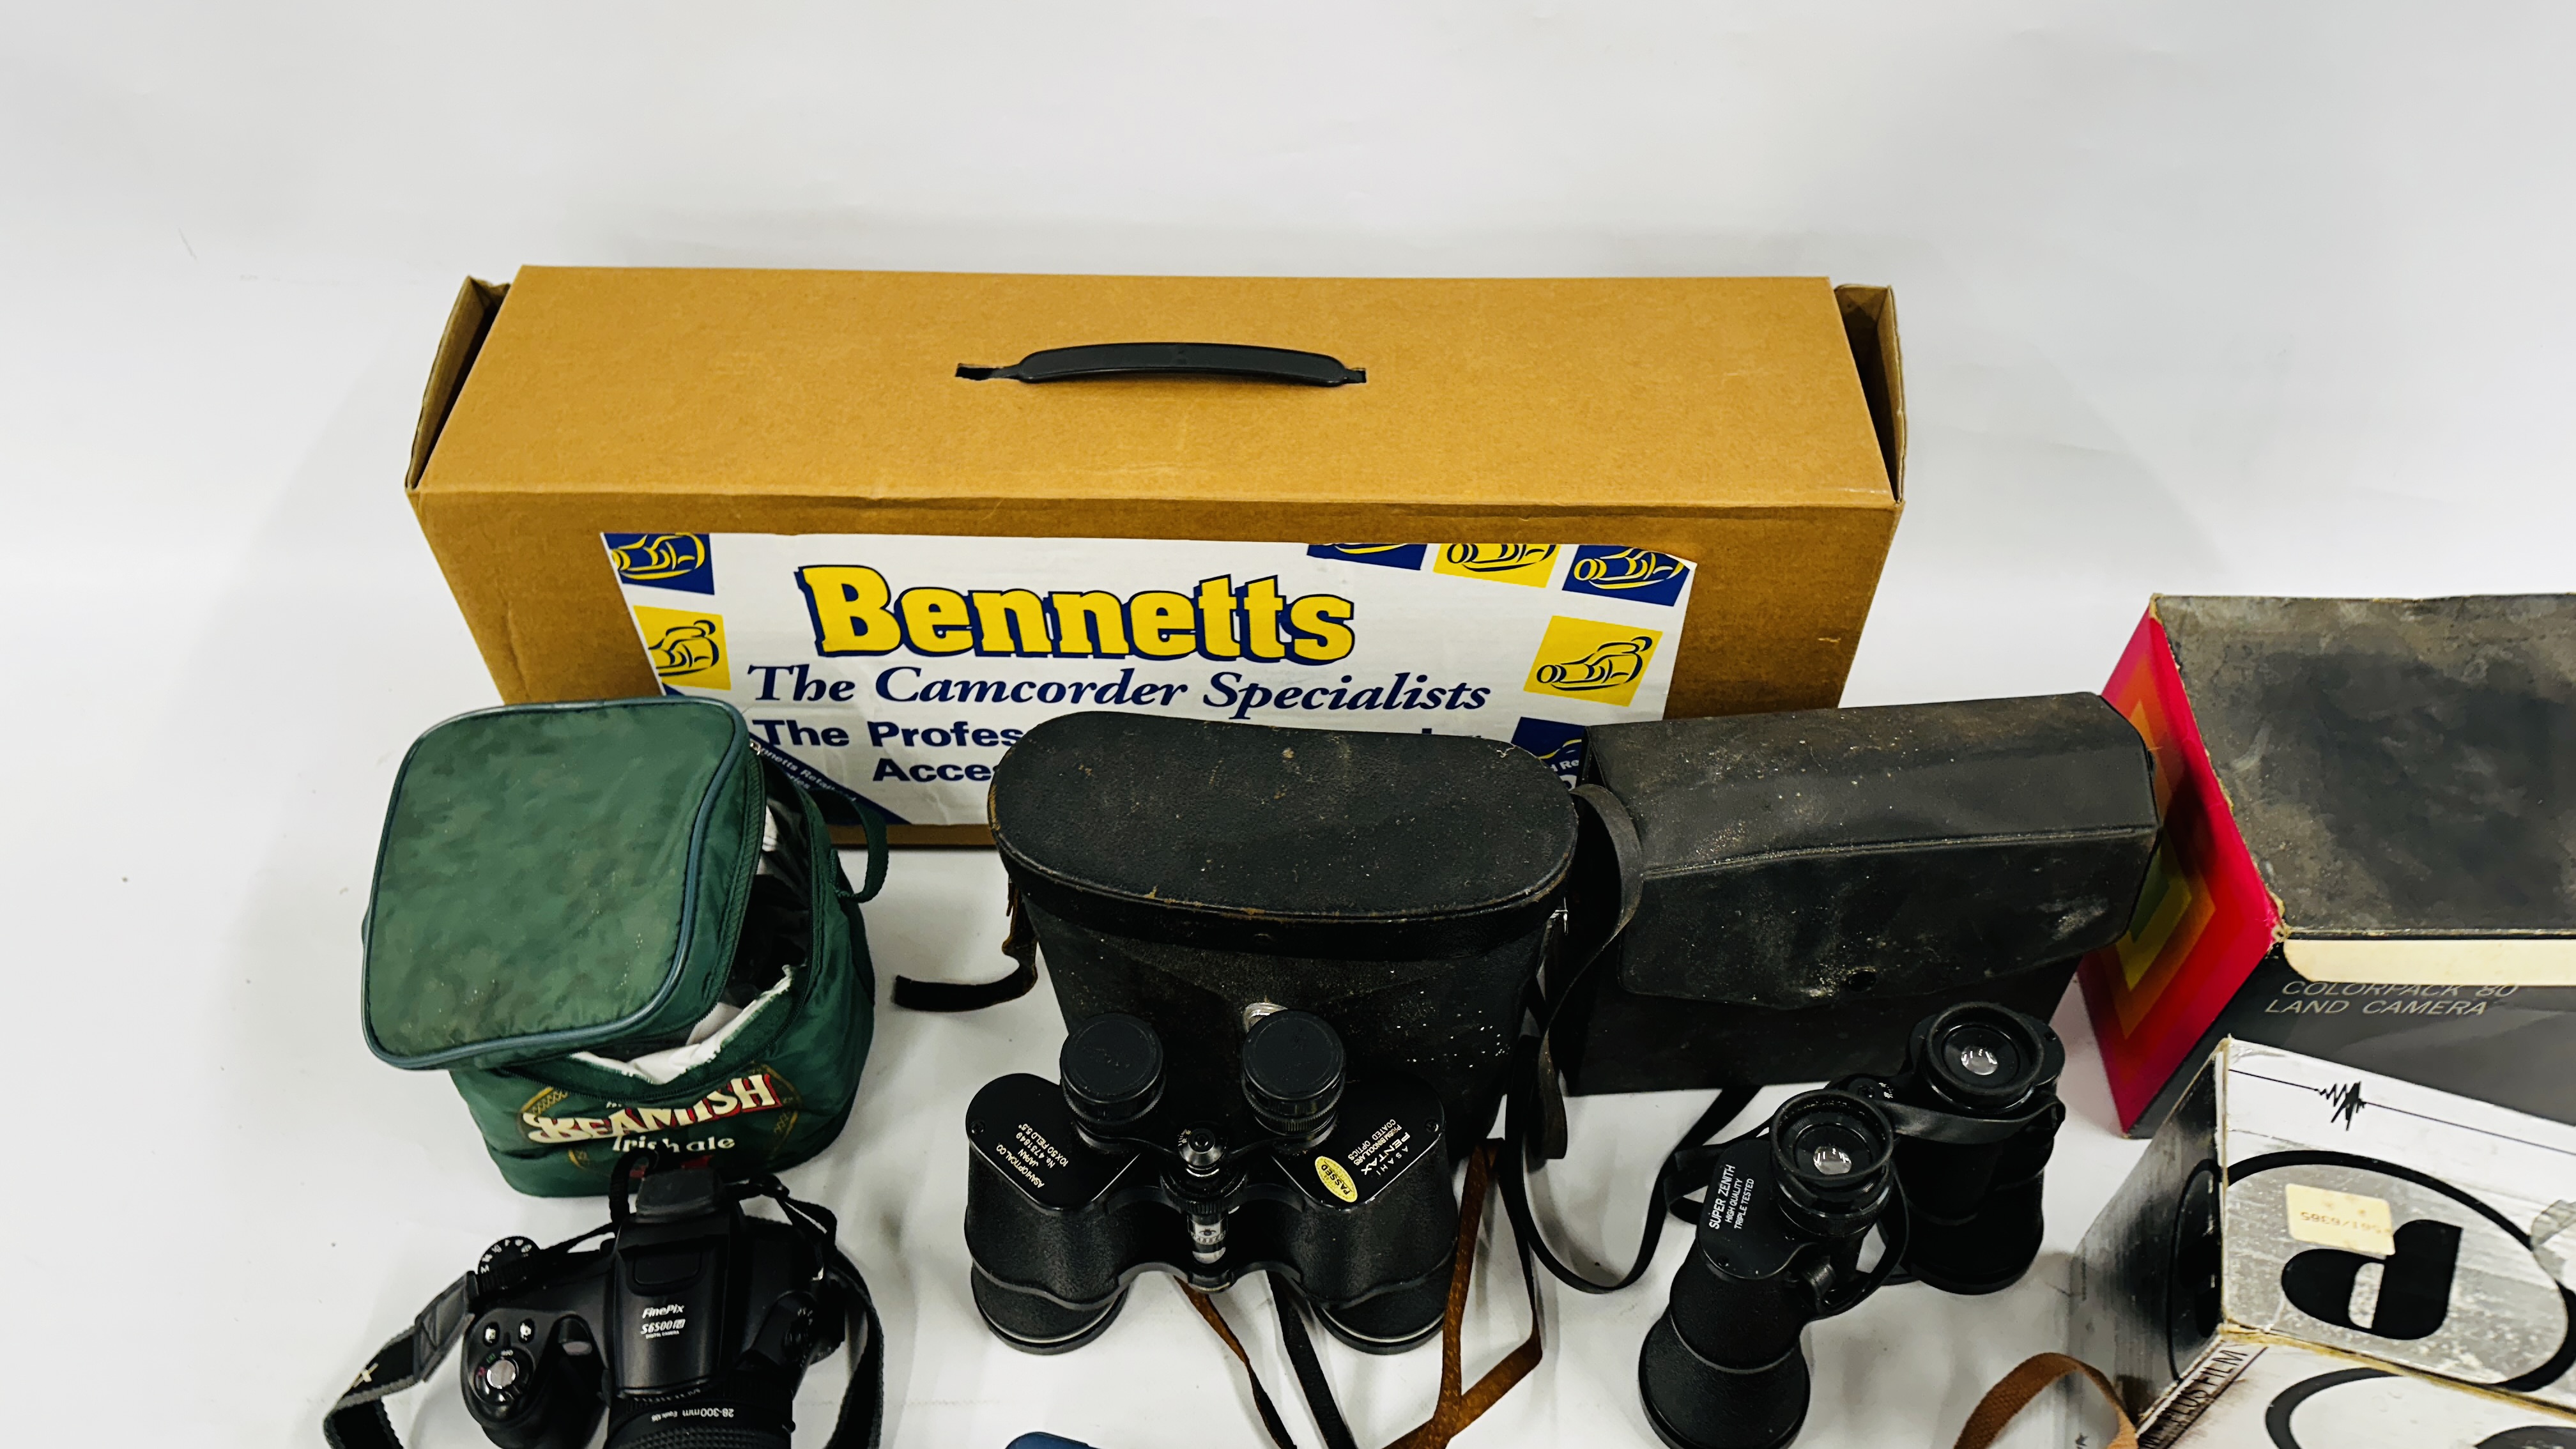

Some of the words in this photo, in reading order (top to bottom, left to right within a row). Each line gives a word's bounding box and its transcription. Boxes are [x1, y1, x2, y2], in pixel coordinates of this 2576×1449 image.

[794, 564, 1354, 665] Bennetts
[747, 664, 855, 702] The
[875, 666, 1187, 708] Camcorder
[1202, 671, 1491, 720] Specialists
[752, 719, 850, 747] The
[873, 758, 998, 782] Acce
[2265, 999, 2350, 1014] LAND
[2362, 1000, 2489, 1015] CAMERA
[523, 1073, 783, 1144] BEAMISH
[1031, 1131, 1050, 1149] FIELD
[1372, 1119, 1396, 1140] COATED
[686, 1136, 735, 1153] ale
[1347, 1140, 1371, 1161] OPTICS
[1361, 1131, 1411, 1176] PENTAX
[1017, 1148, 1039, 1167] JAPAN
[1376, 1146, 1409, 1176] ASAHI
[1321, 1164, 1351, 1195] PASSED
[1729, 1177, 1743, 1206] QUALITY
[1740, 1178, 1754, 1204] TESTED
[1708, 1198, 1726, 1230] SUPER
[1717, 1164, 1736, 1197] ZENITH
[1724, 1206, 1736, 1223] HIGH
[1733, 1204, 1748, 1229] TRIPLE
[641, 1303, 685, 1319] FinePix
[682, 1407, 735, 1418] 28-300mm
